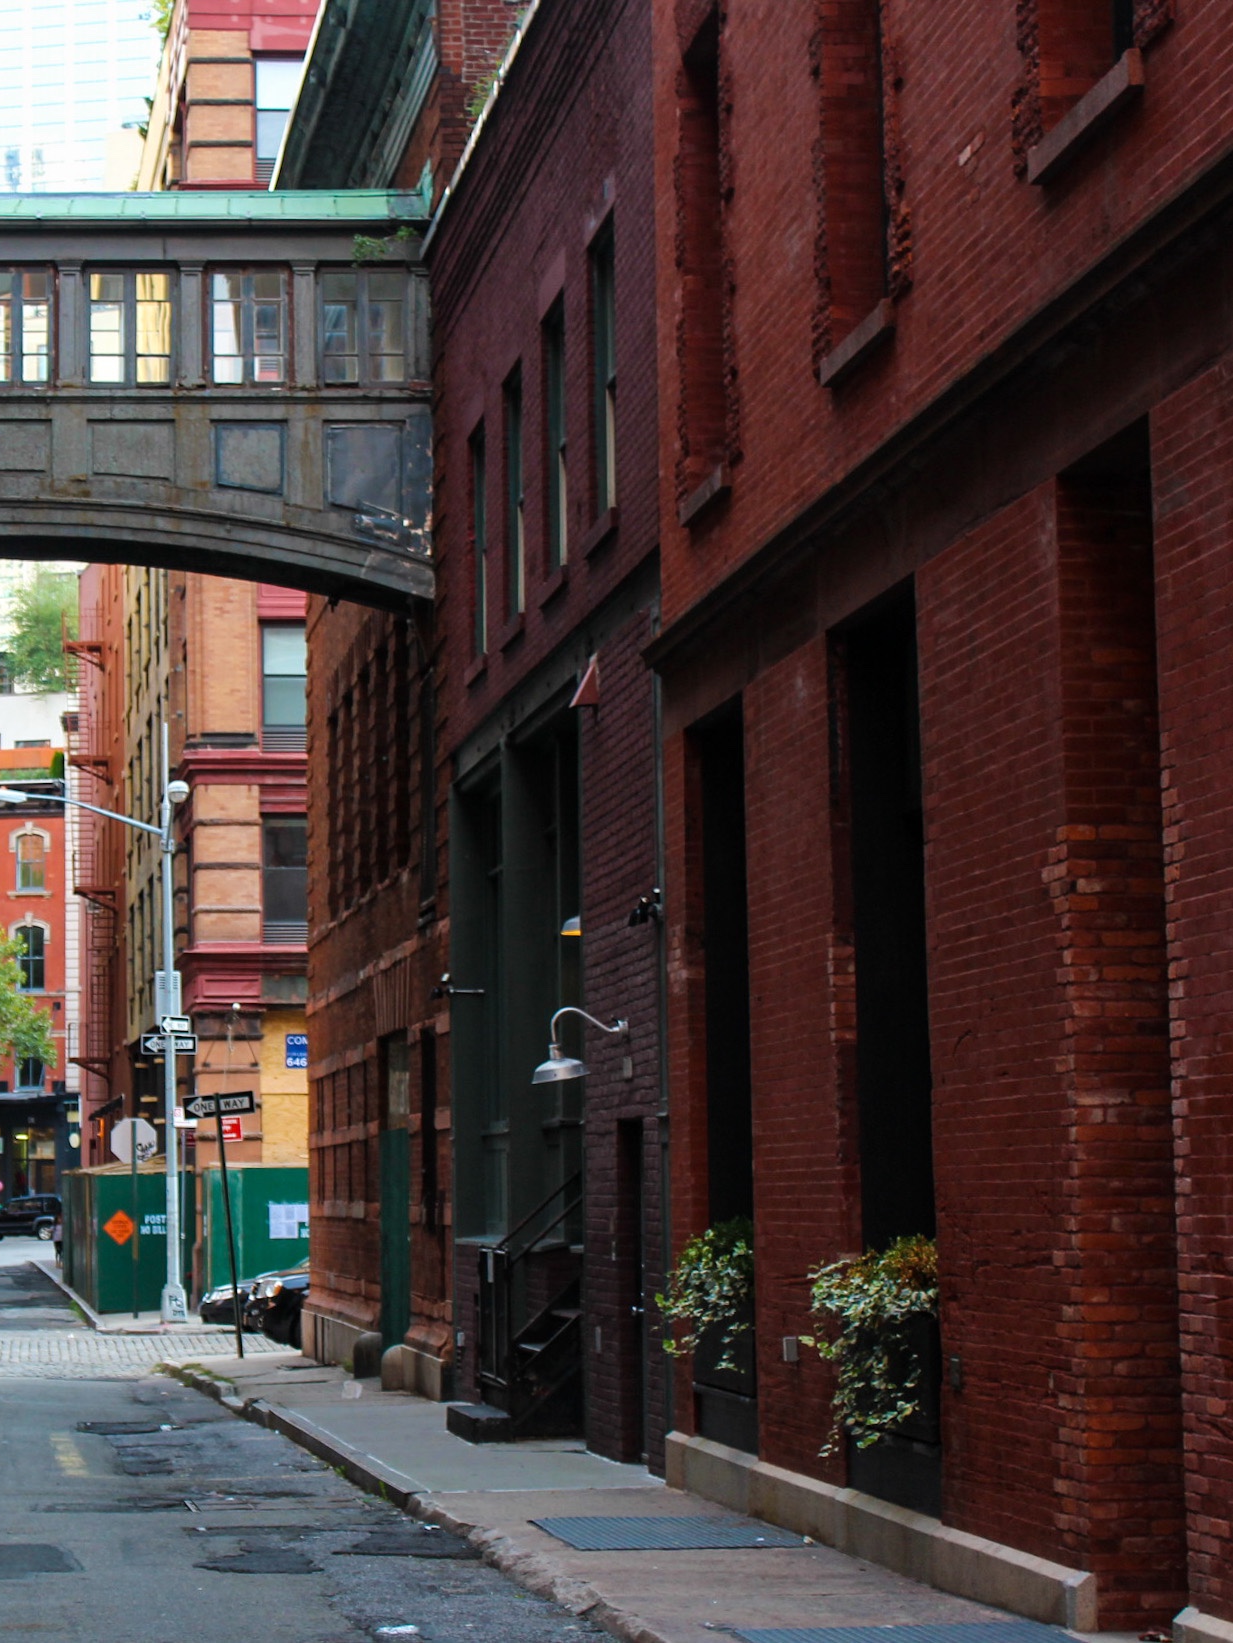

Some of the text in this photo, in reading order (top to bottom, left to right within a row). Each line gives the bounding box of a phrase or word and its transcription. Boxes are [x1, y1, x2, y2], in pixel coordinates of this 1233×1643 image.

[150, 1039, 166, 1049] ONE
[286, 1057, 308, 1067] 646
[193, 1098, 245, 1112] ONE WAY
[144, 1214, 167, 1224] POST
[139, 1225, 151, 1235] NO
[152, 1225, 167, 1235] BILL
